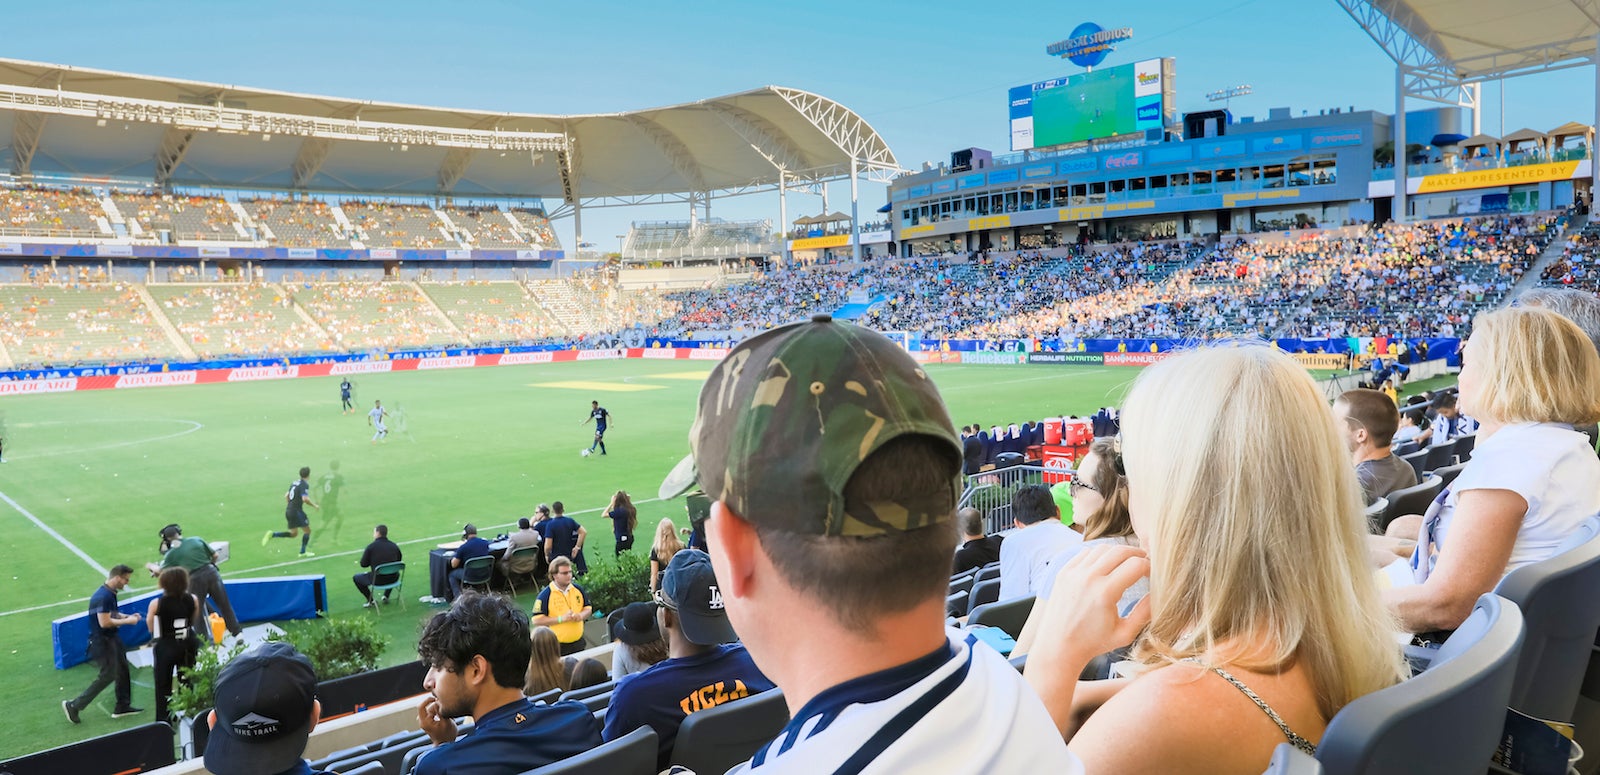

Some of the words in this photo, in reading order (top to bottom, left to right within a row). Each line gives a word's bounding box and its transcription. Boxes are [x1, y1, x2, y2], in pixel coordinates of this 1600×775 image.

[1089, 26, 1128, 44] STUDIOS
[1326, 134, 1360, 142] TOYOTA
[1426, 177, 1466, 187] MATCH
[1472, 169, 1545, 183] PRESENTED
[1551, 166, 1566, 175] BY
[421, 358, 472, 367] ADVOCARE
[503, 353, 550, 362] ADVOCARE
[961, 352, 1016, 364] Heineken
[1029, 354, 1065, 362] HERBALIFE
[333, 362, 389, 372] ADVOCARE
[121, 373, 192, 385] ADVOCARE
[708, 585, 724, 609] LA
[680, 680, 749, 715] UCLA
[233, 727, 251, 736] NIKE
[253, 726, 277, 736] TRAIL
